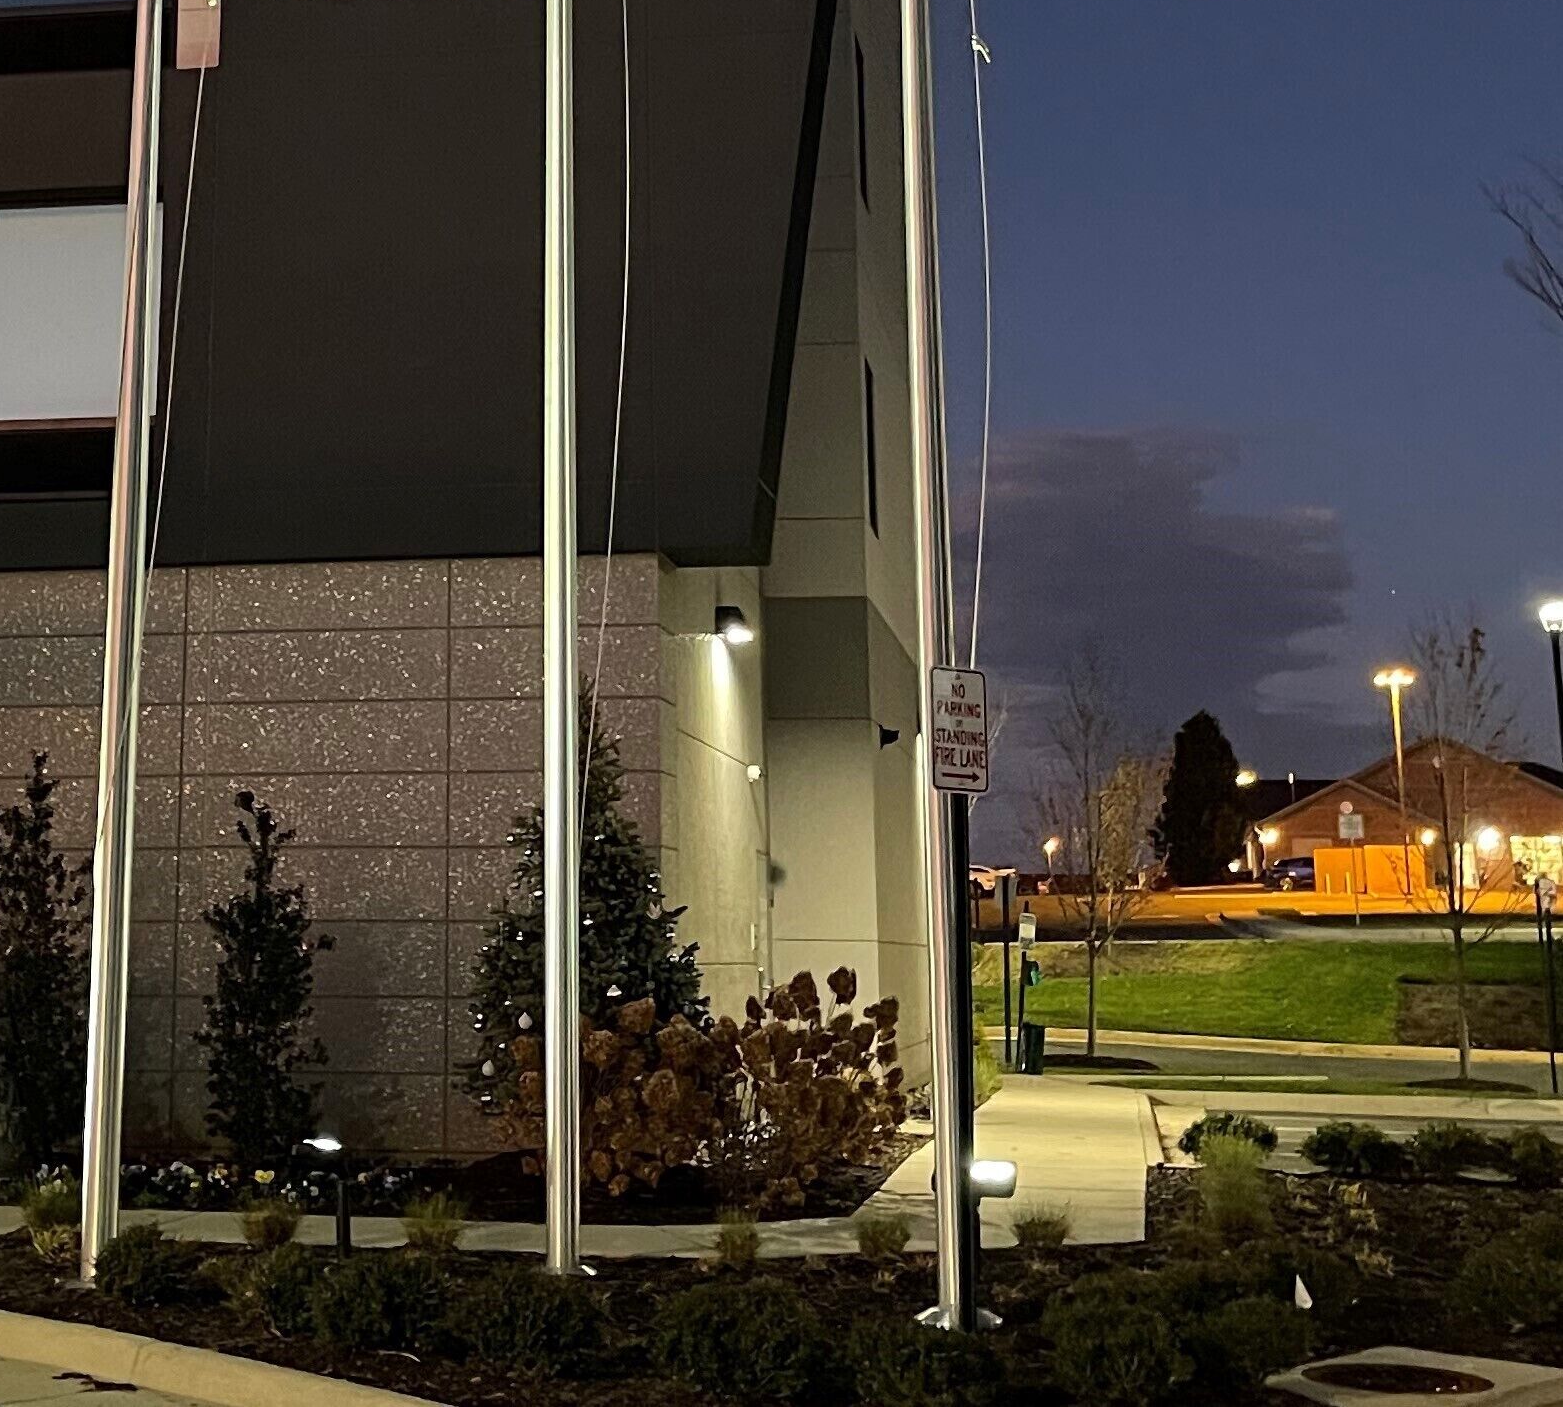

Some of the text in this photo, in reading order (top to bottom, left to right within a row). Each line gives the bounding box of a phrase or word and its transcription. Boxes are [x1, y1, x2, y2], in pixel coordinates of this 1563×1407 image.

[951, 683, 966, 699] NO
[936, 701, 982, 719] PARKING
[935, 728, 985, 748] STANDING
[935, 746, 986, 769] FIRE LANE
